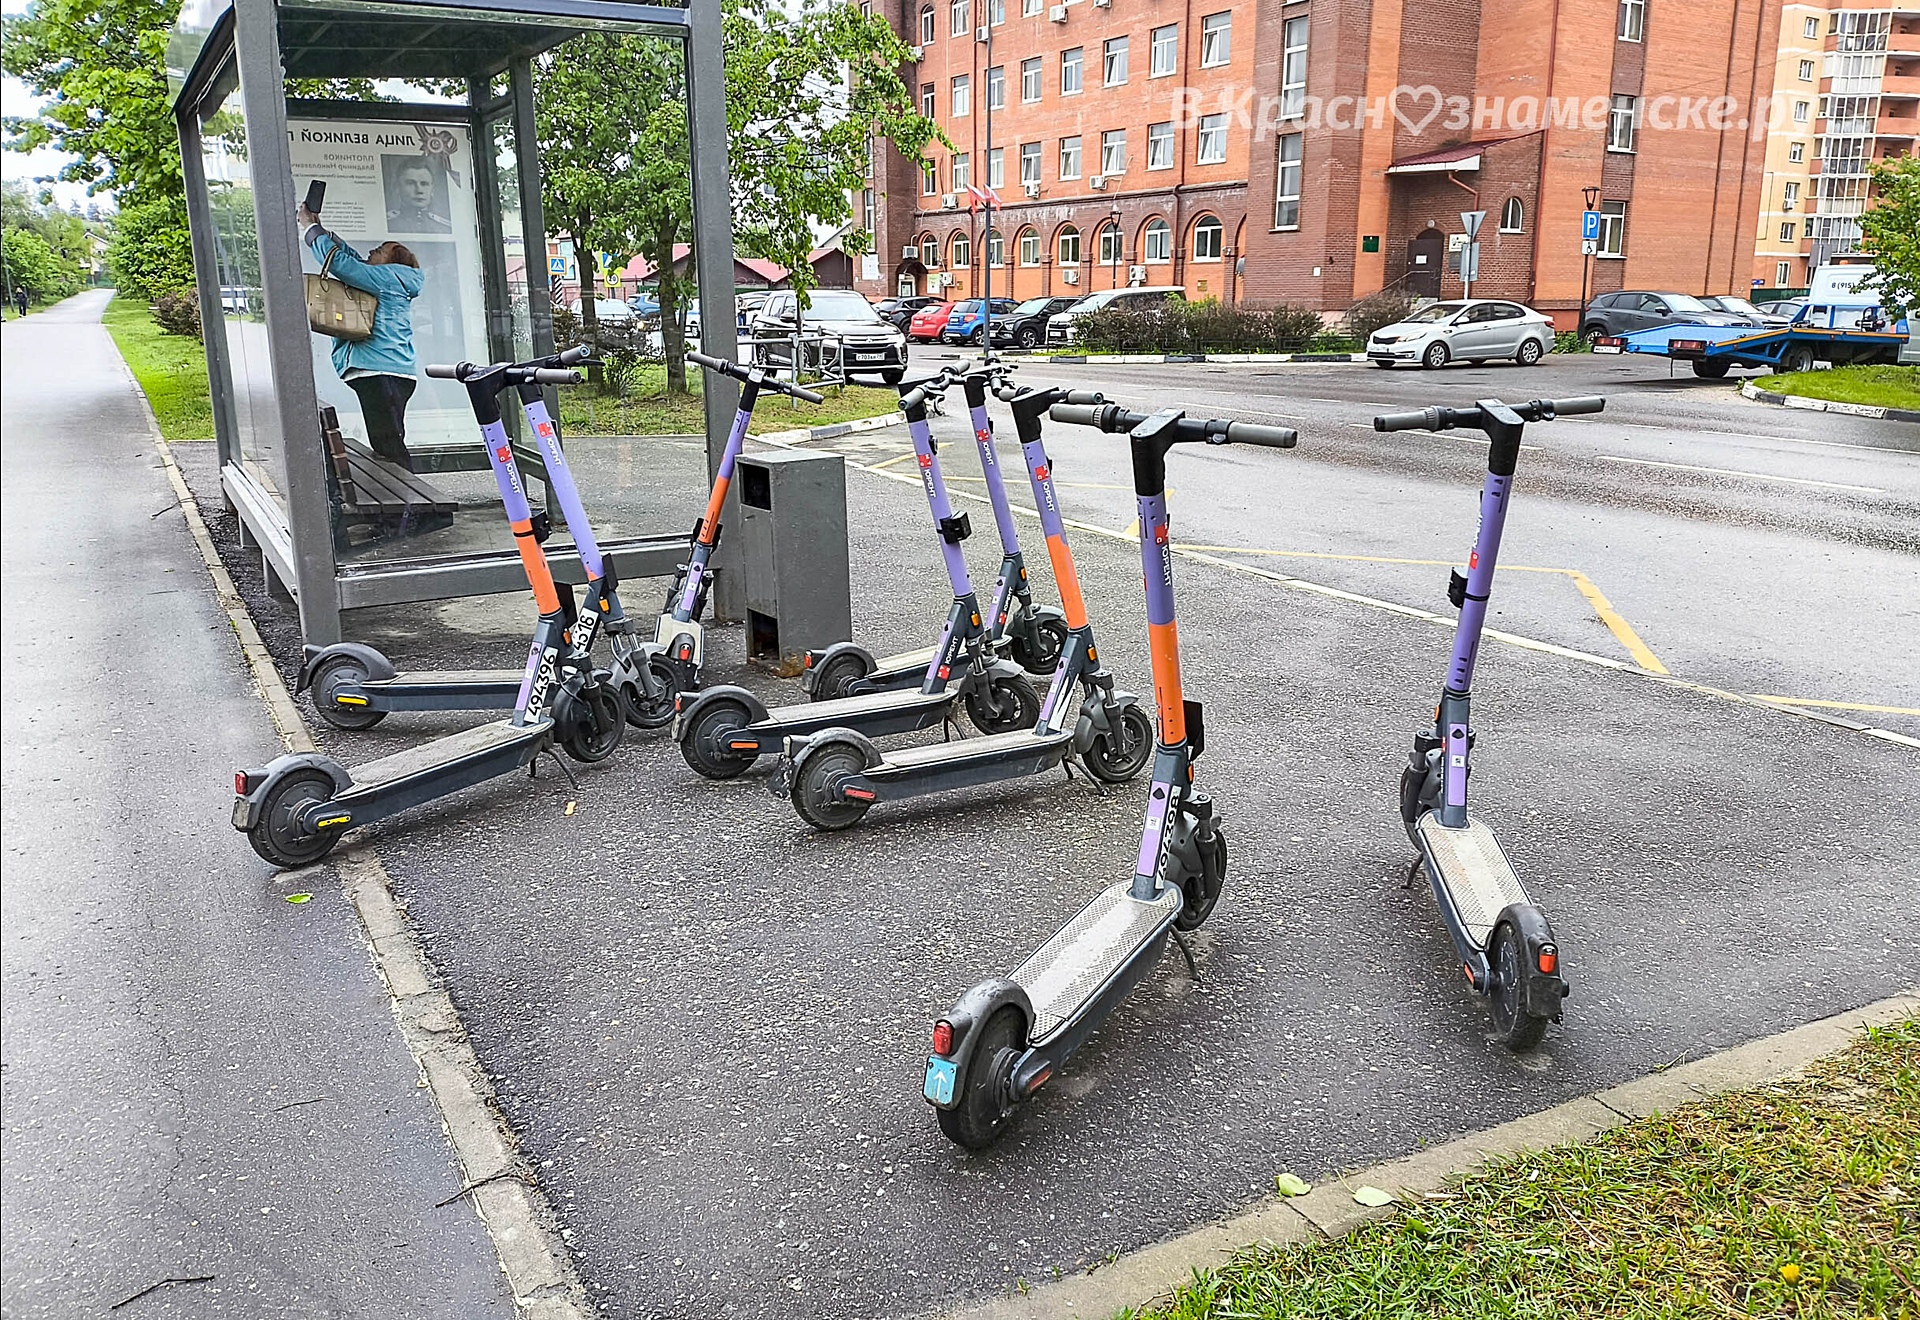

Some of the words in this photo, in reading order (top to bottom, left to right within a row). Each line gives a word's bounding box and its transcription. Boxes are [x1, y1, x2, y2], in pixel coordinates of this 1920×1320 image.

[1586, 214, 1597, 236] P
[547, 437, 562, 466] ЮРЕНТ
[982, 441, 994, 466] ЮРЕНТ
[506, 462, 520, 494] ЮРЕНТ
[923, 468, 937, 498] ЮРЕНТ
[1042, 481, 1055, 512] ЮРЕНТ
[1161, 544, 1172, 587] ЮРЕНТ
[945, 635, 959, 665] ЮРЕНТ
[528, 654, 555, 716] 494396
